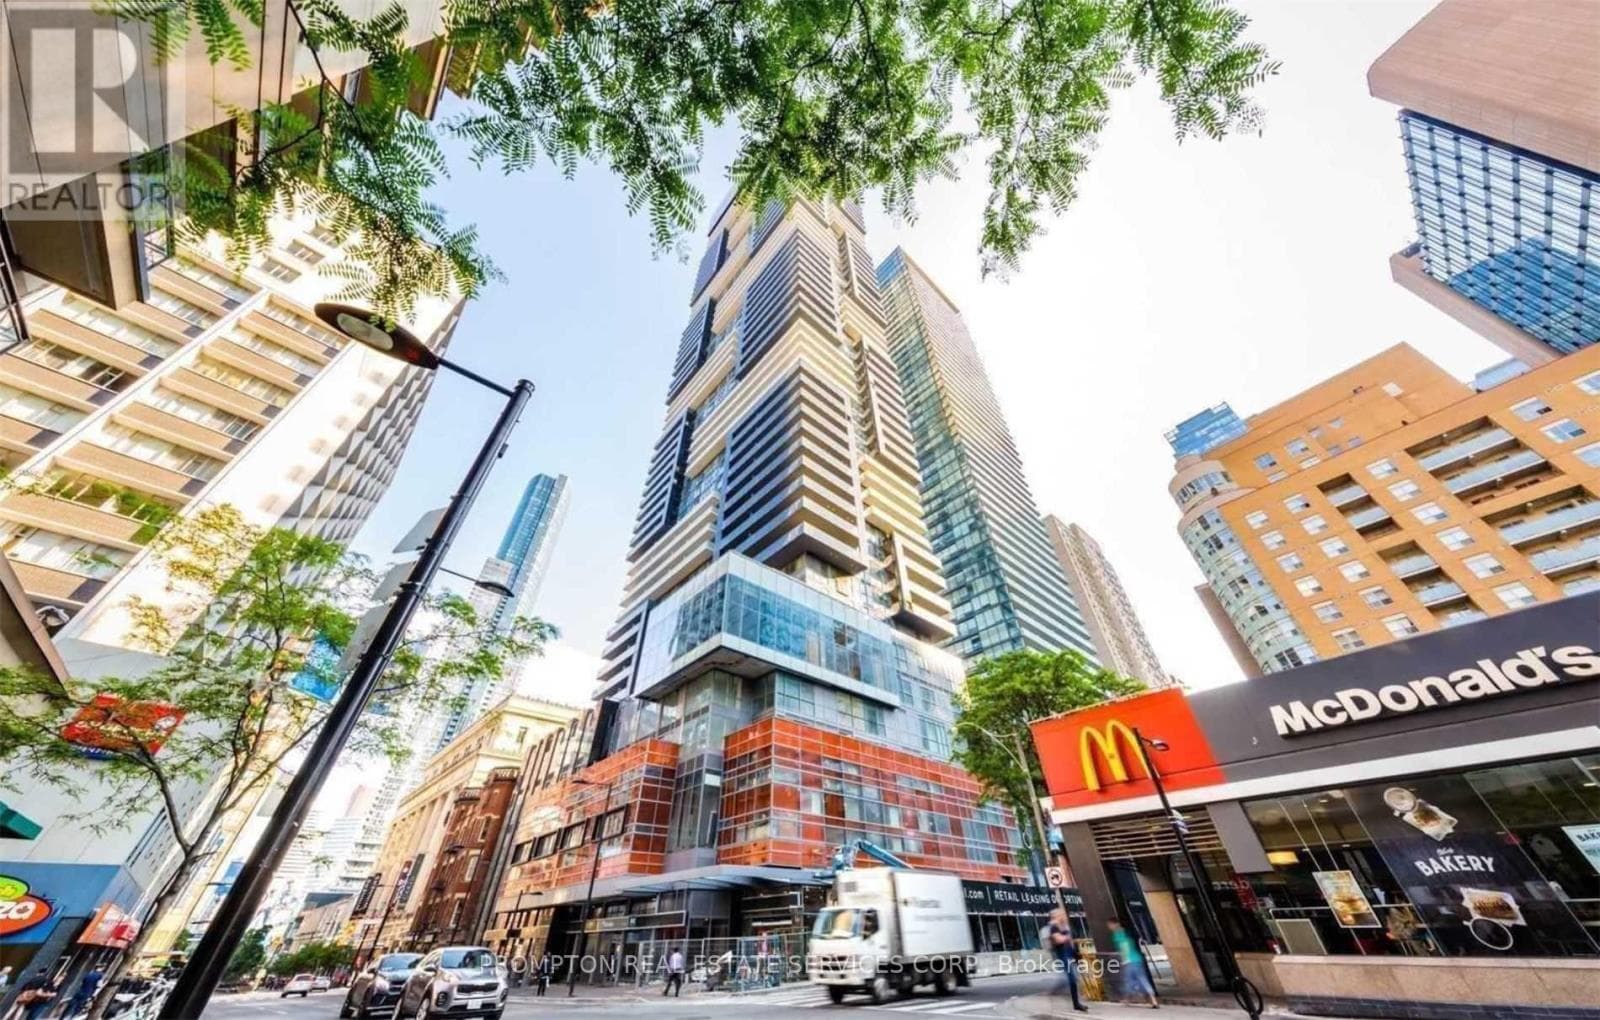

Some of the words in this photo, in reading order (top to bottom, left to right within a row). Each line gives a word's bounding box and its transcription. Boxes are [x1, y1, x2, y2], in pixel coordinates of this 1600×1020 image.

[1269, 645, 1600, 737] McDonald's
[1414, 855, 1495, 876] BAKERY
[994, 889, 1020, 902] RETAIL
[1021, 892, 1050, 904] LEASING
